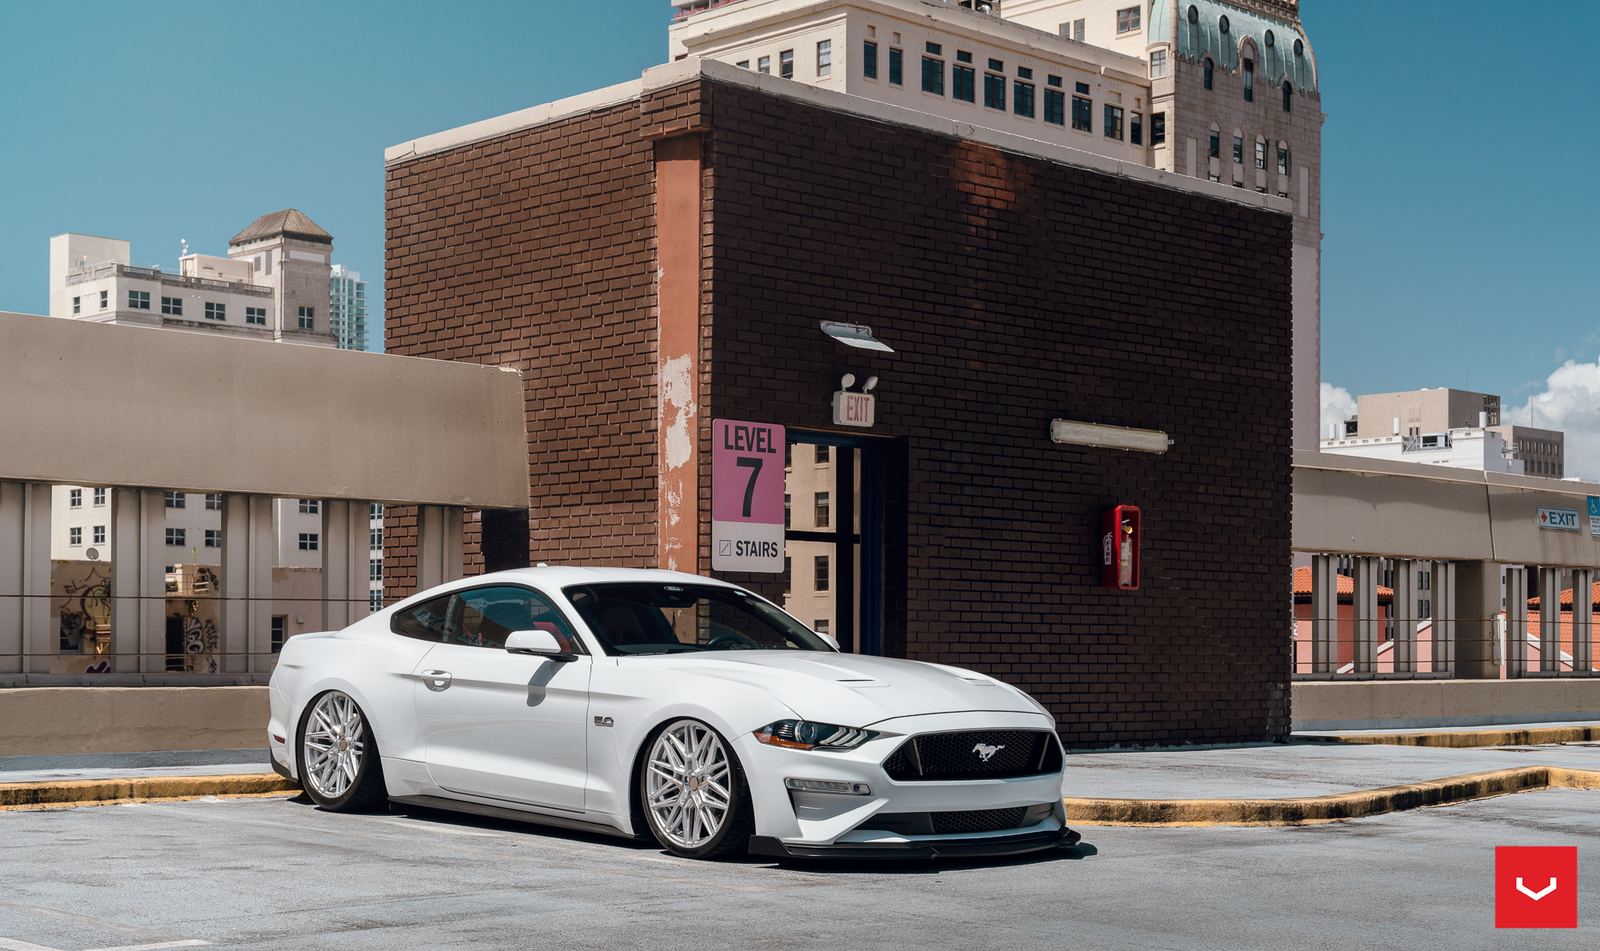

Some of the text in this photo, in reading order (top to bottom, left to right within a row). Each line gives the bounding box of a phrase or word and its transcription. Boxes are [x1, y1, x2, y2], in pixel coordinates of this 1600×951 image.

[847, 396, 870, 422] EXIT
[724, 424, 777, 454] LEVEL
[736, 456, 763, 518] 7
[1549, 511, 1576, 526] EXIT
[735, 540, 778, 558] STAIRS
